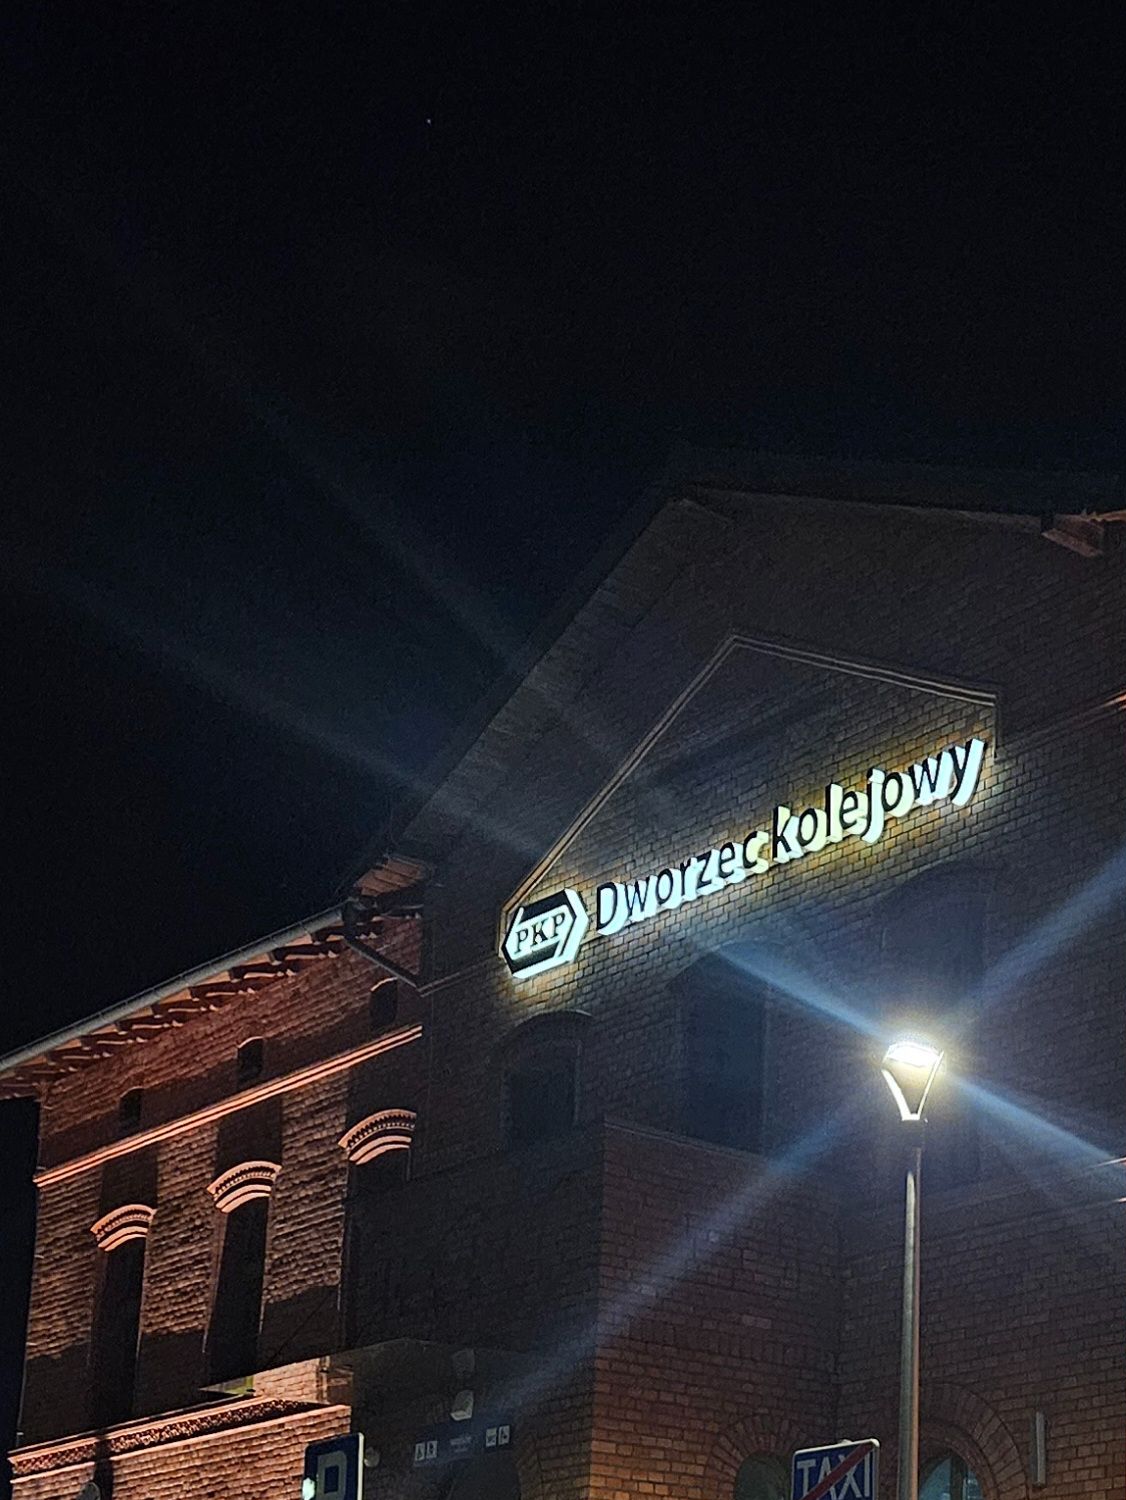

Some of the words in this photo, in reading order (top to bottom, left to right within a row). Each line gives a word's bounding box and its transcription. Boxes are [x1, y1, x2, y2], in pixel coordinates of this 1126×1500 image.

[513, 911, 567, 955] PKP
[596, 829, 769, 936] Dworzec
[771, 737, 986, 864] kolejowy
